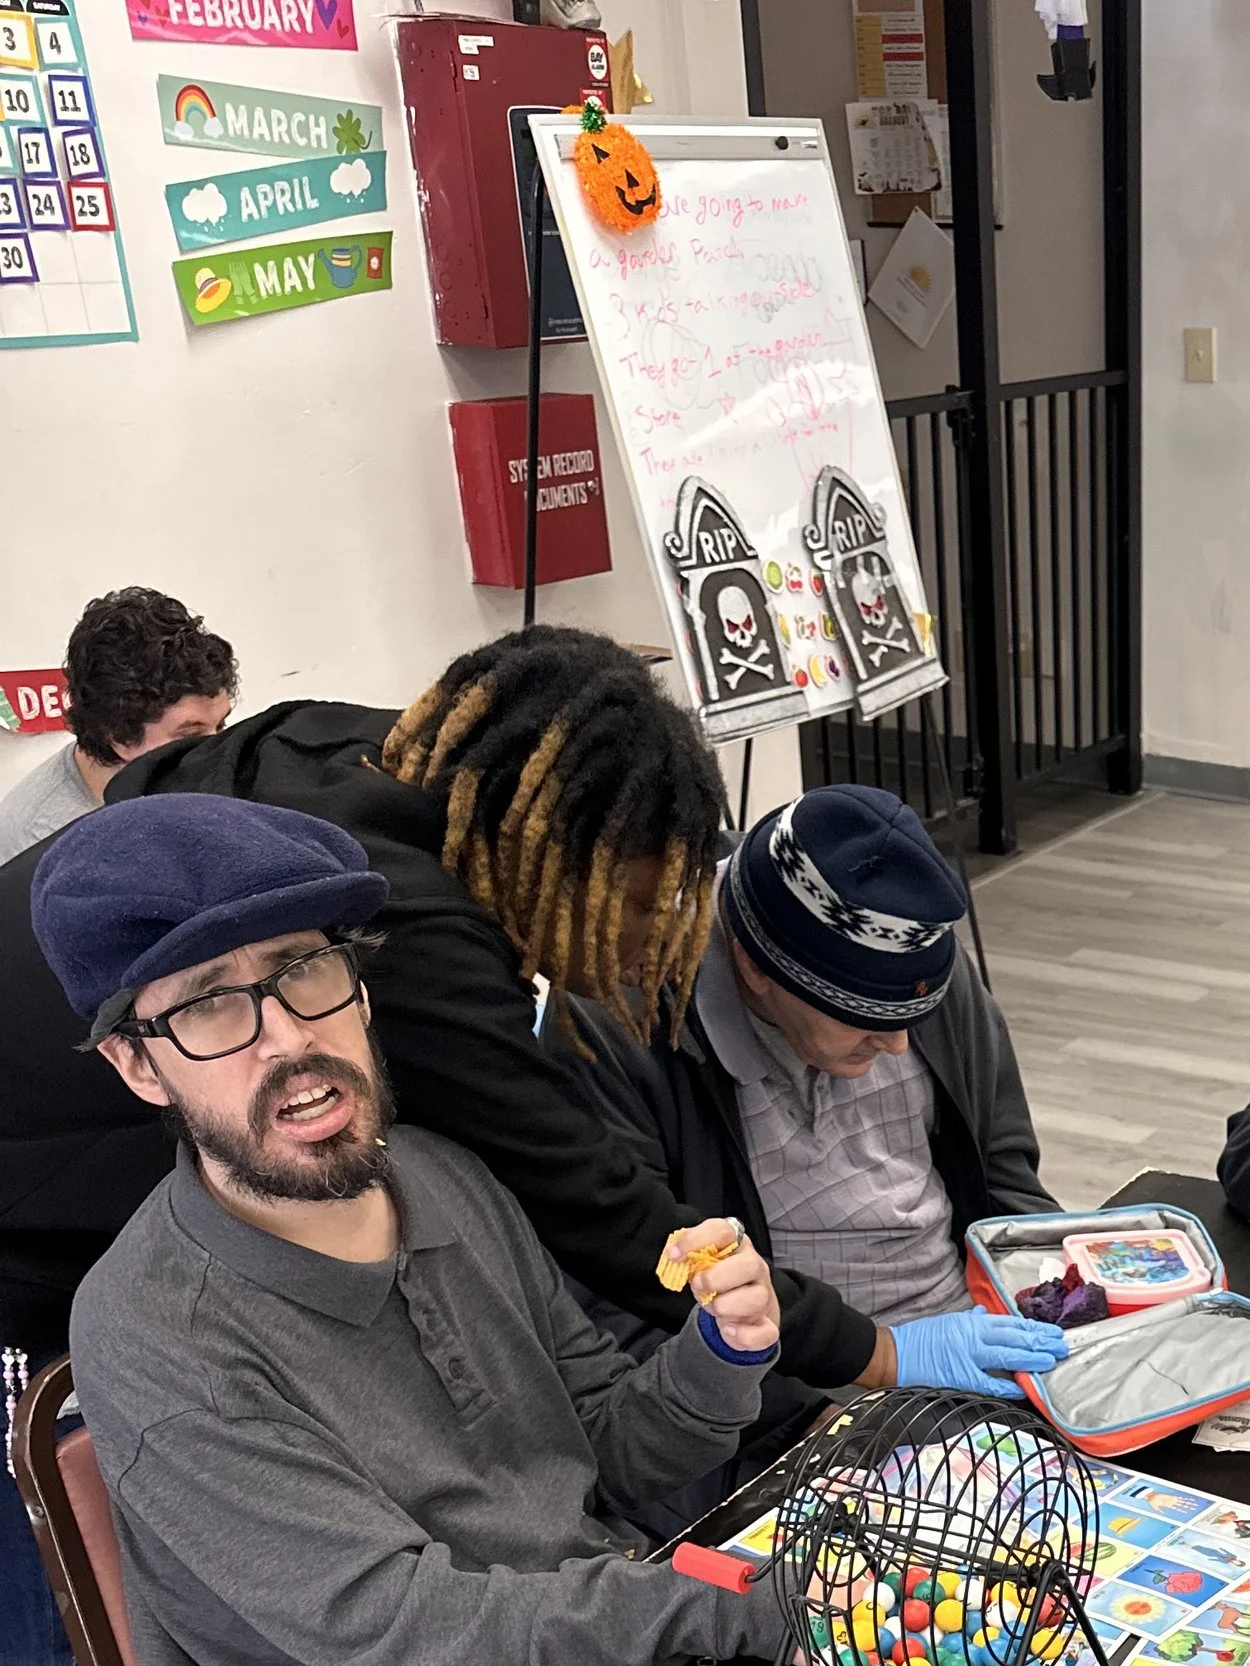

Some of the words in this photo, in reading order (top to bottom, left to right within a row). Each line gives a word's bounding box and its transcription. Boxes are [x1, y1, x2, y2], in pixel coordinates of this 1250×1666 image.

[168, 0, 318, 34] FEBRUARY
[3, 27, 17, 50] 3
[49, 32, 62, 55] 4
[590, 52, 603, 63] BAY
[4, 89, 30, 113] 10
[57, 89, 82, 112] 11
[224, 101, 328, 149] MARCH
[24, 141, 41, 165] 17
[69, 143, 91, 167] 18
[32, 193, 56, 216] 24
[76, 195, 100, 218] 25
[239, 176, 320, 223] APRIL
[696, 194, 745, 228] going
[2, 246, 24, 269] 30
[253, 252, 317, 300] MAY
[508, 456, 552, 483] SYSEM
[552, 449, 595, 476] RECORD
[524, 482, 588, 512] CUMENTS
[699, 528, 738, 564] RIP
[833, 516, 868, 551] RIP
